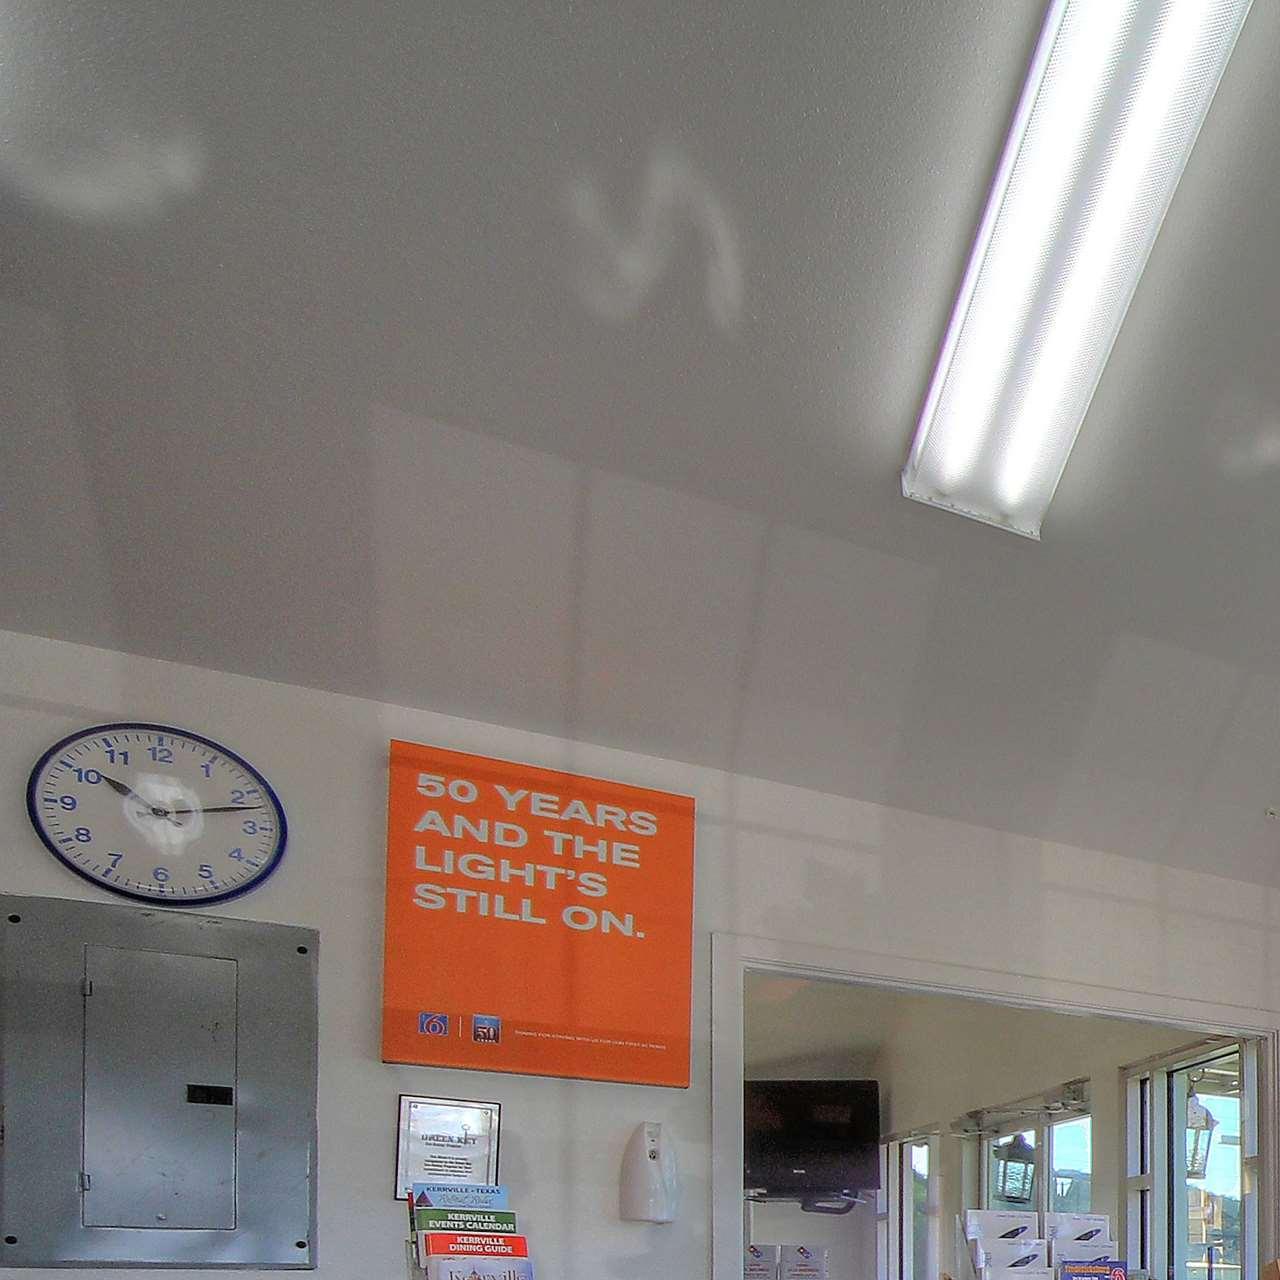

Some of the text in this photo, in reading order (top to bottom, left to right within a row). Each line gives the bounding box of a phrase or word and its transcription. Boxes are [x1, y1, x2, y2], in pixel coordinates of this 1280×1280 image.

[105, 749, 130, 766] 11
[147, 746, 173, 764] 12
[73, 767, 103, 785] 10
[201, 763, 212, 778] 1
[59, 795, 78, 812] 9
[231, 790, 246, 806] 2
[416, 773, 658, 837] 50 YEARS
[74, 827, 93, 843] 8
[242, 820, 259, 835] 3
[413, 809, 641, 869] AND THE
[108, 852, 123, 867] 7
[228, 848, 245, 862] 4
[153, 867, 170, 883] 6
[197, 864, 213, 880] 5
[415, 845, 608, 898] LIGHT'S
[412, 883, 646, 939] STILL ON.
[423, 1013, 447, 1036] 6
[476, 1026, 497, 1040] 50
[447, 1212, 496, 1222] KERRVILLE
[429, 1220, 515, 1231] EVENTS CALENDAR
[456, 1235, 505, 1245] KERRVILLE
[449, 1244, 513, 1253] DINING GUIDE
